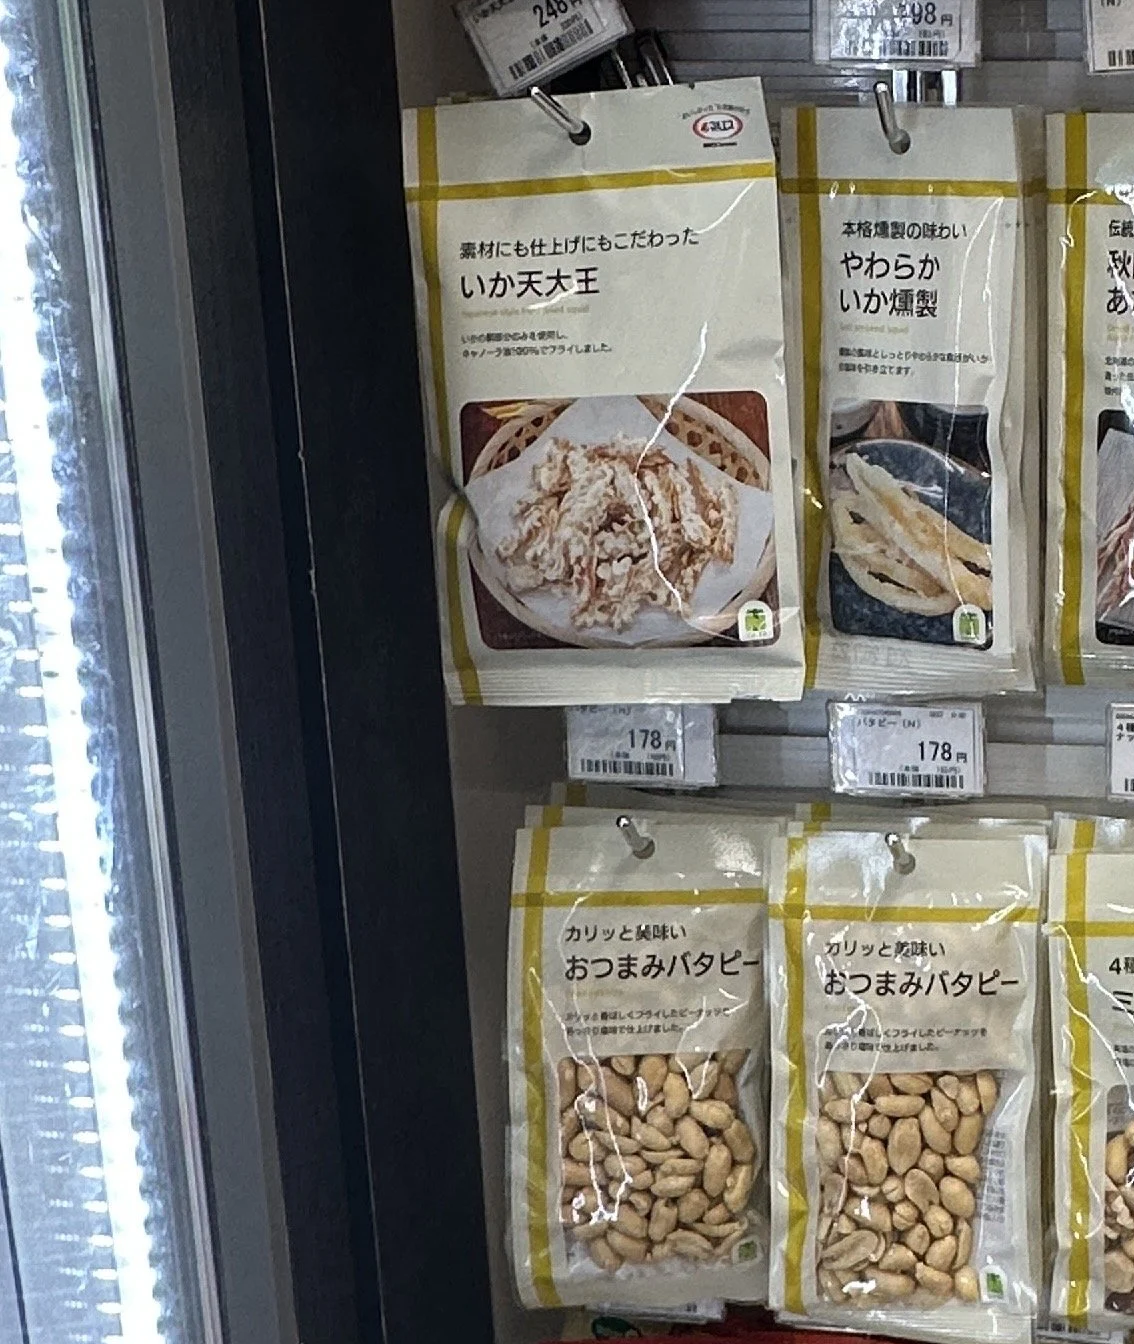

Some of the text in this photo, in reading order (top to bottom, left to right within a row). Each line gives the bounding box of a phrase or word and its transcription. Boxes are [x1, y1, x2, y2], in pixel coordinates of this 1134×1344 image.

[459, 226, 701, 260] 素材にも仕上げにもこだわった
[841, 220, 969, 241] 本格燻製の味わい
[839, 249, 941, 281] やわらか
[459, 265, 601, 300] いか天大王
[839, 287, 939, 319] いか燻製
[565, 924, 688, 943] カリッと美味い
[825, 940, 946, 958] カリッと美味い
[564, 948, 761, 982] おつまみバタピー
[823, 968, 1020, 998] おつまみバタピー
